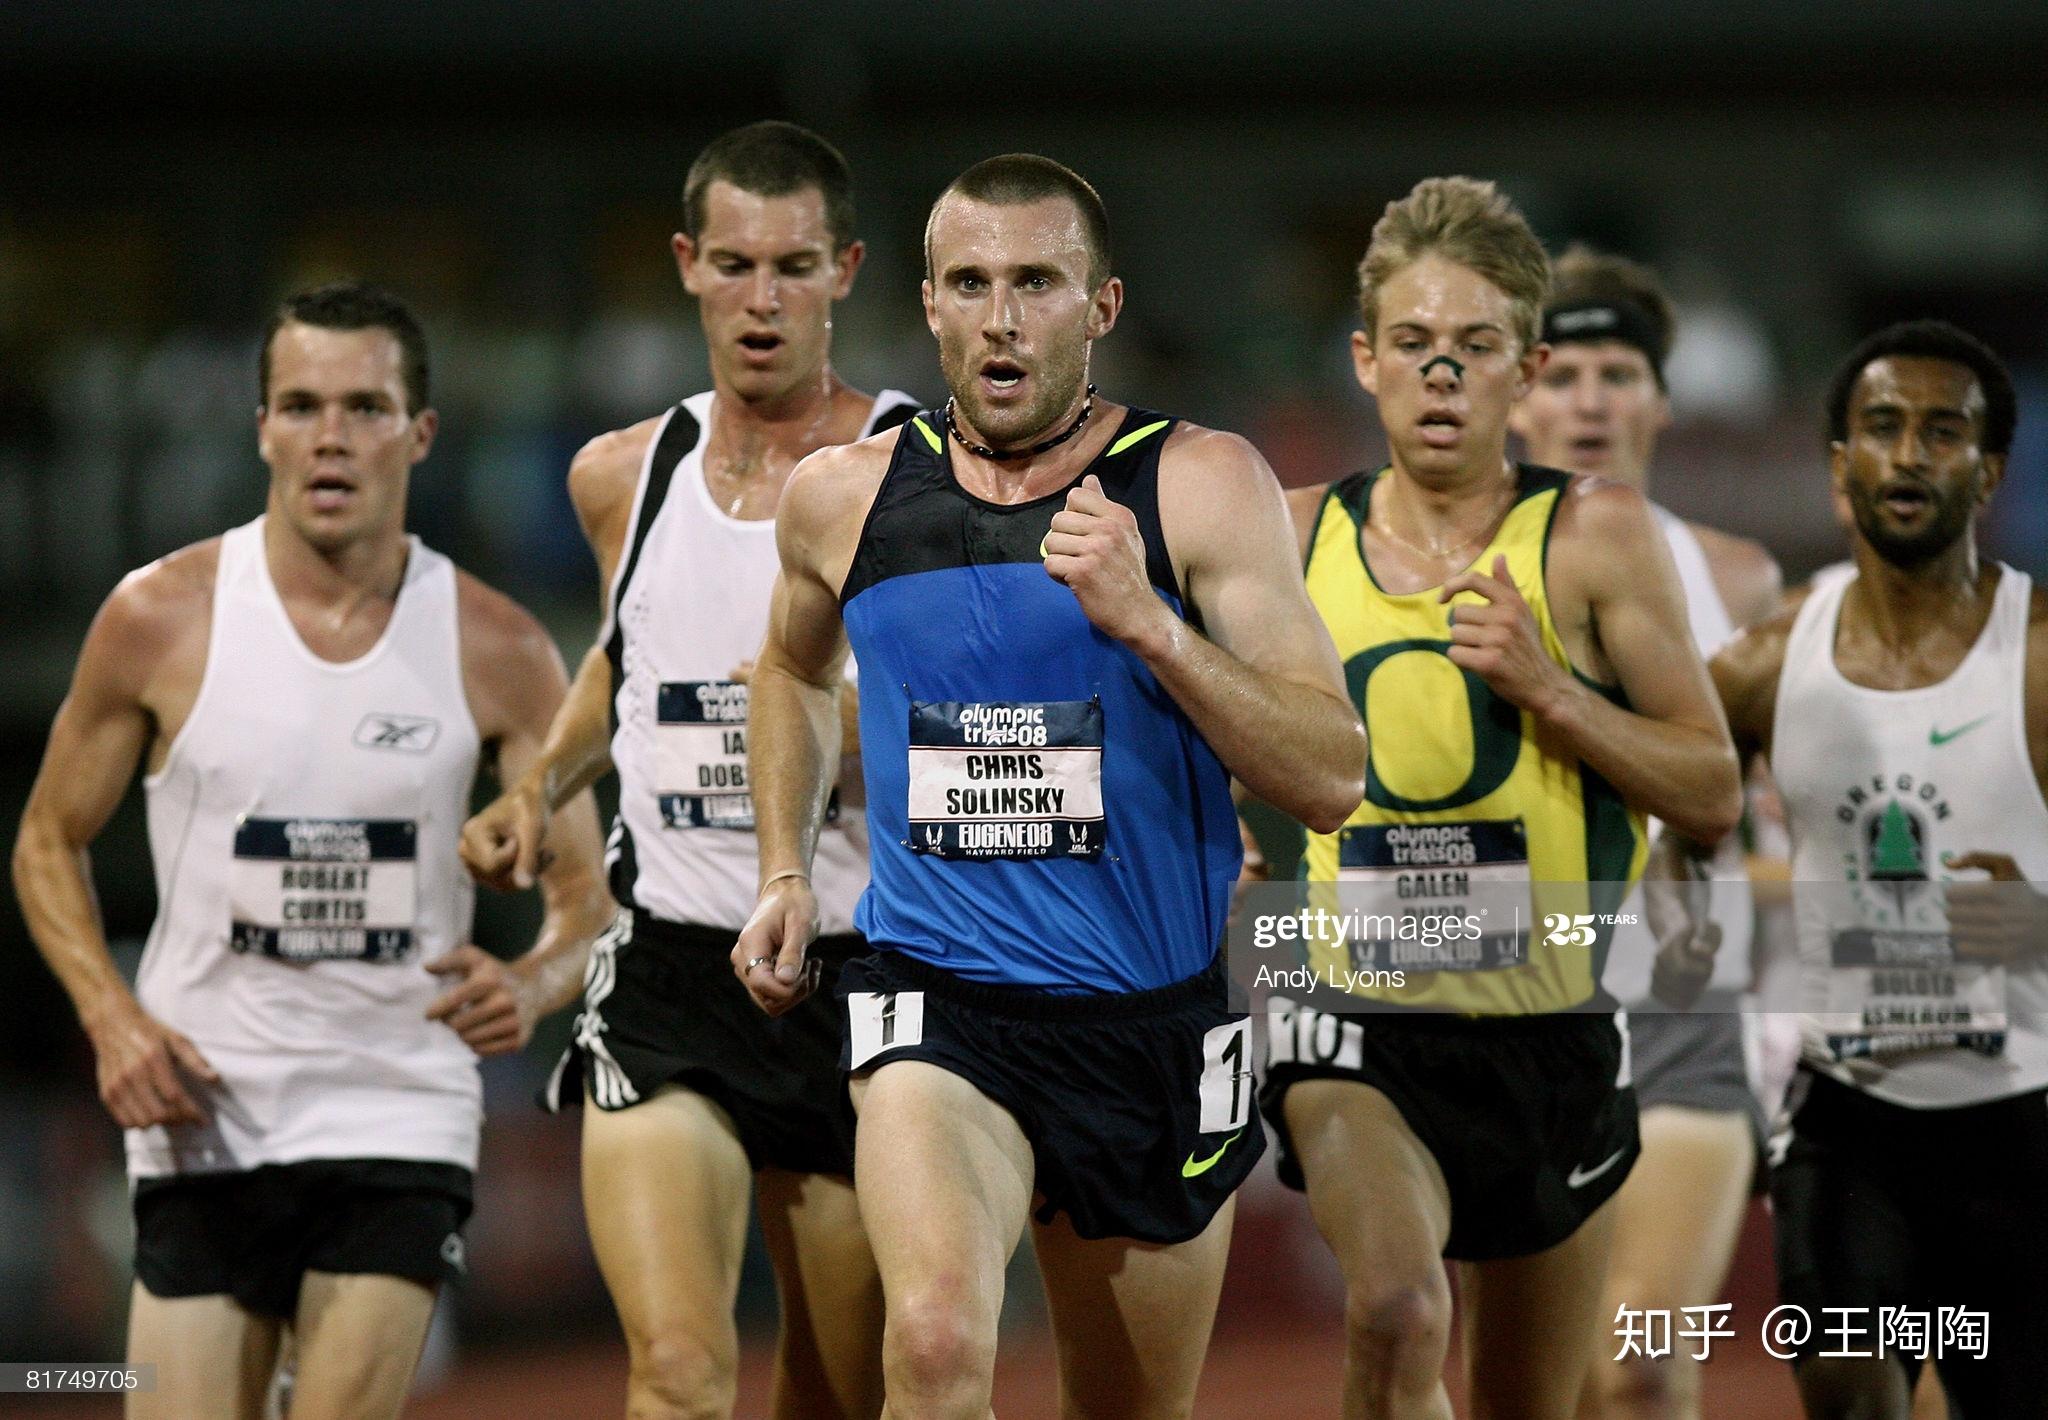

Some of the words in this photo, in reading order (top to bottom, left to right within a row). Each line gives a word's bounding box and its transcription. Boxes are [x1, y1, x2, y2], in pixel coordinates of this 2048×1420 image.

[959, 703, 1044, 730] olympic
[1343, 638, 1521, 812] O
[724, 732, 745, 754] IA
[699, 764, 744, 787] DOB
[966, 754, 1044, 780] CHRIS
[946, 787, 1065, 815] SOLINSKY
[1836, 774, 1952, 825] OREGON
[958, 823, 1053, 849] EUGENE08
[1386, 825, 1471, 848] olympic
[282, 867, 368, 890] ROBERT
[1397, 872, 1470, 898] GALEN
[283, 898, 365, 920] CURTIS
[1221, 1029, 1243, 1125] 1
